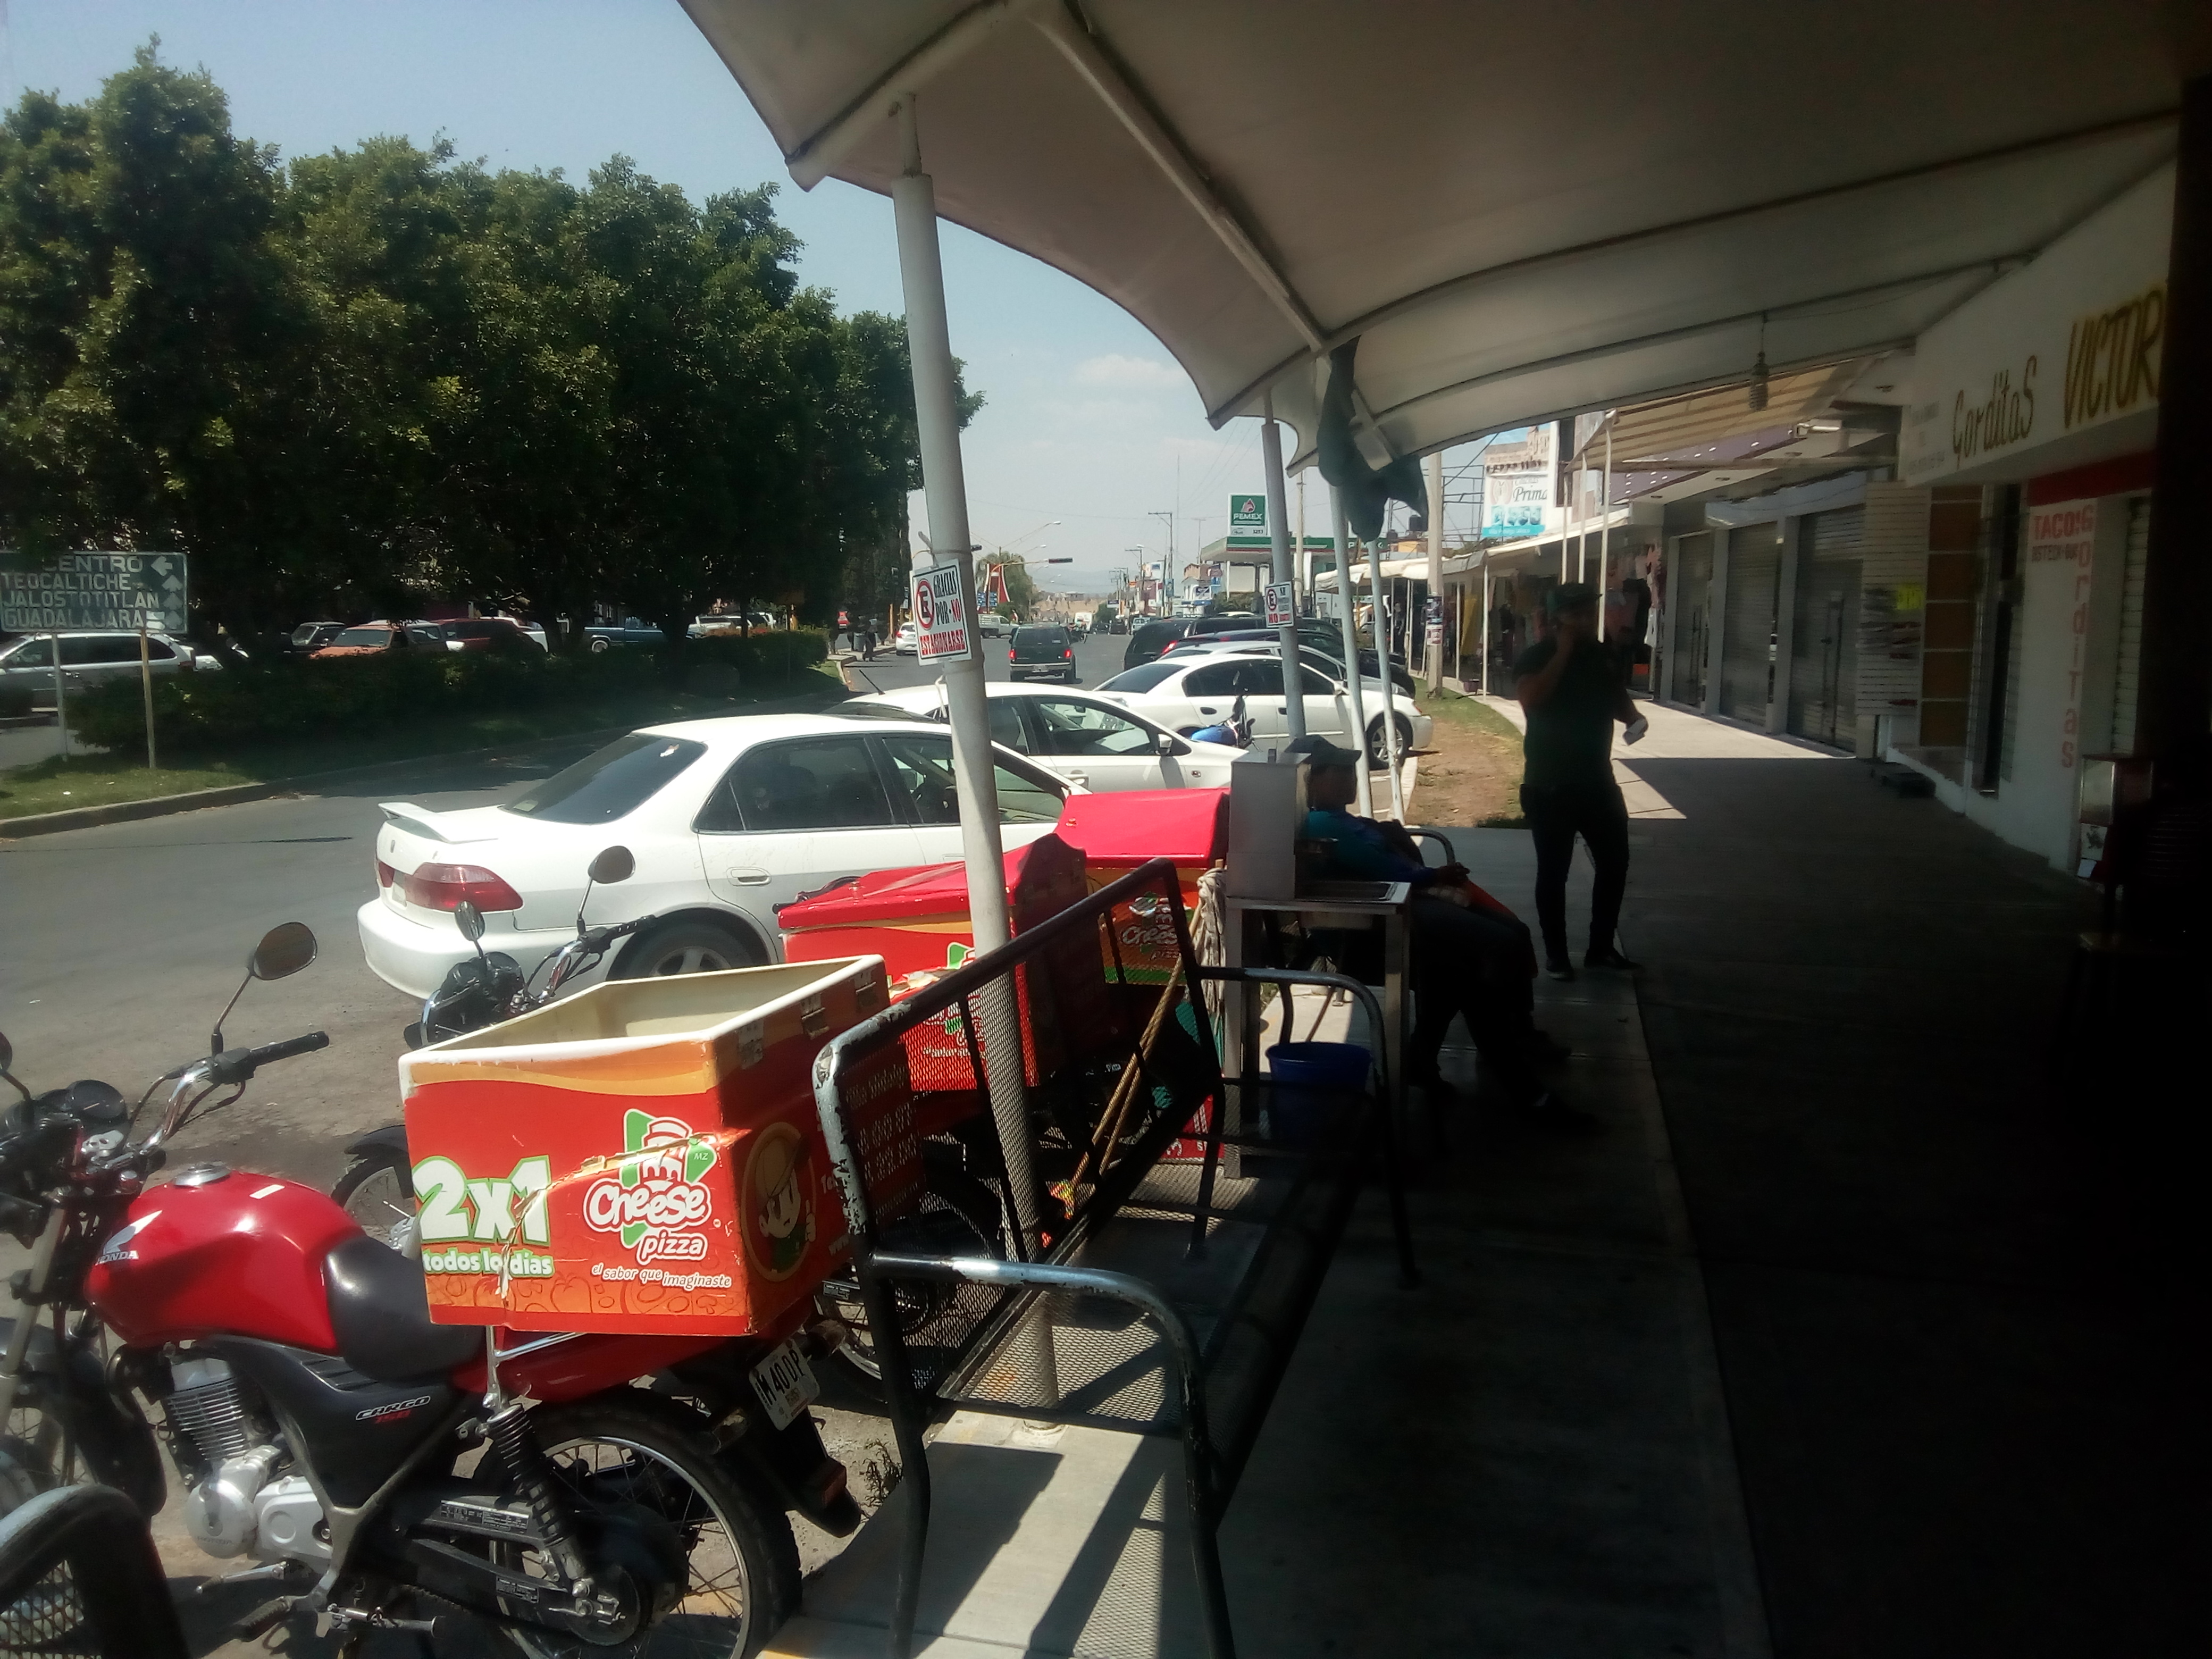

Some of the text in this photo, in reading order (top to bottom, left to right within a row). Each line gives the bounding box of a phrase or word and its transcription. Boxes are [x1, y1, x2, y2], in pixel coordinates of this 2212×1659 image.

[1, 573, 132, 590] TEOCALTICHE
[934, 571, 957, 598] GRACIAS
[3, 589, 160, 609] JALOSTOTITLAN
[5, 609, 144, 628] GUADALAJARA
[412, 1157, 550, 1244] 2x1
[589, 1184, 708, 1226] Cheese
[641, 1231, 703, 1259] pizza
[423, 1250, 481, 1272] todos
[509, 1252, 551, 1275] días
[592, 1263, 731, 1289] el sabor que imaginaste
[356, 1395, 431, 1420] CARGO
